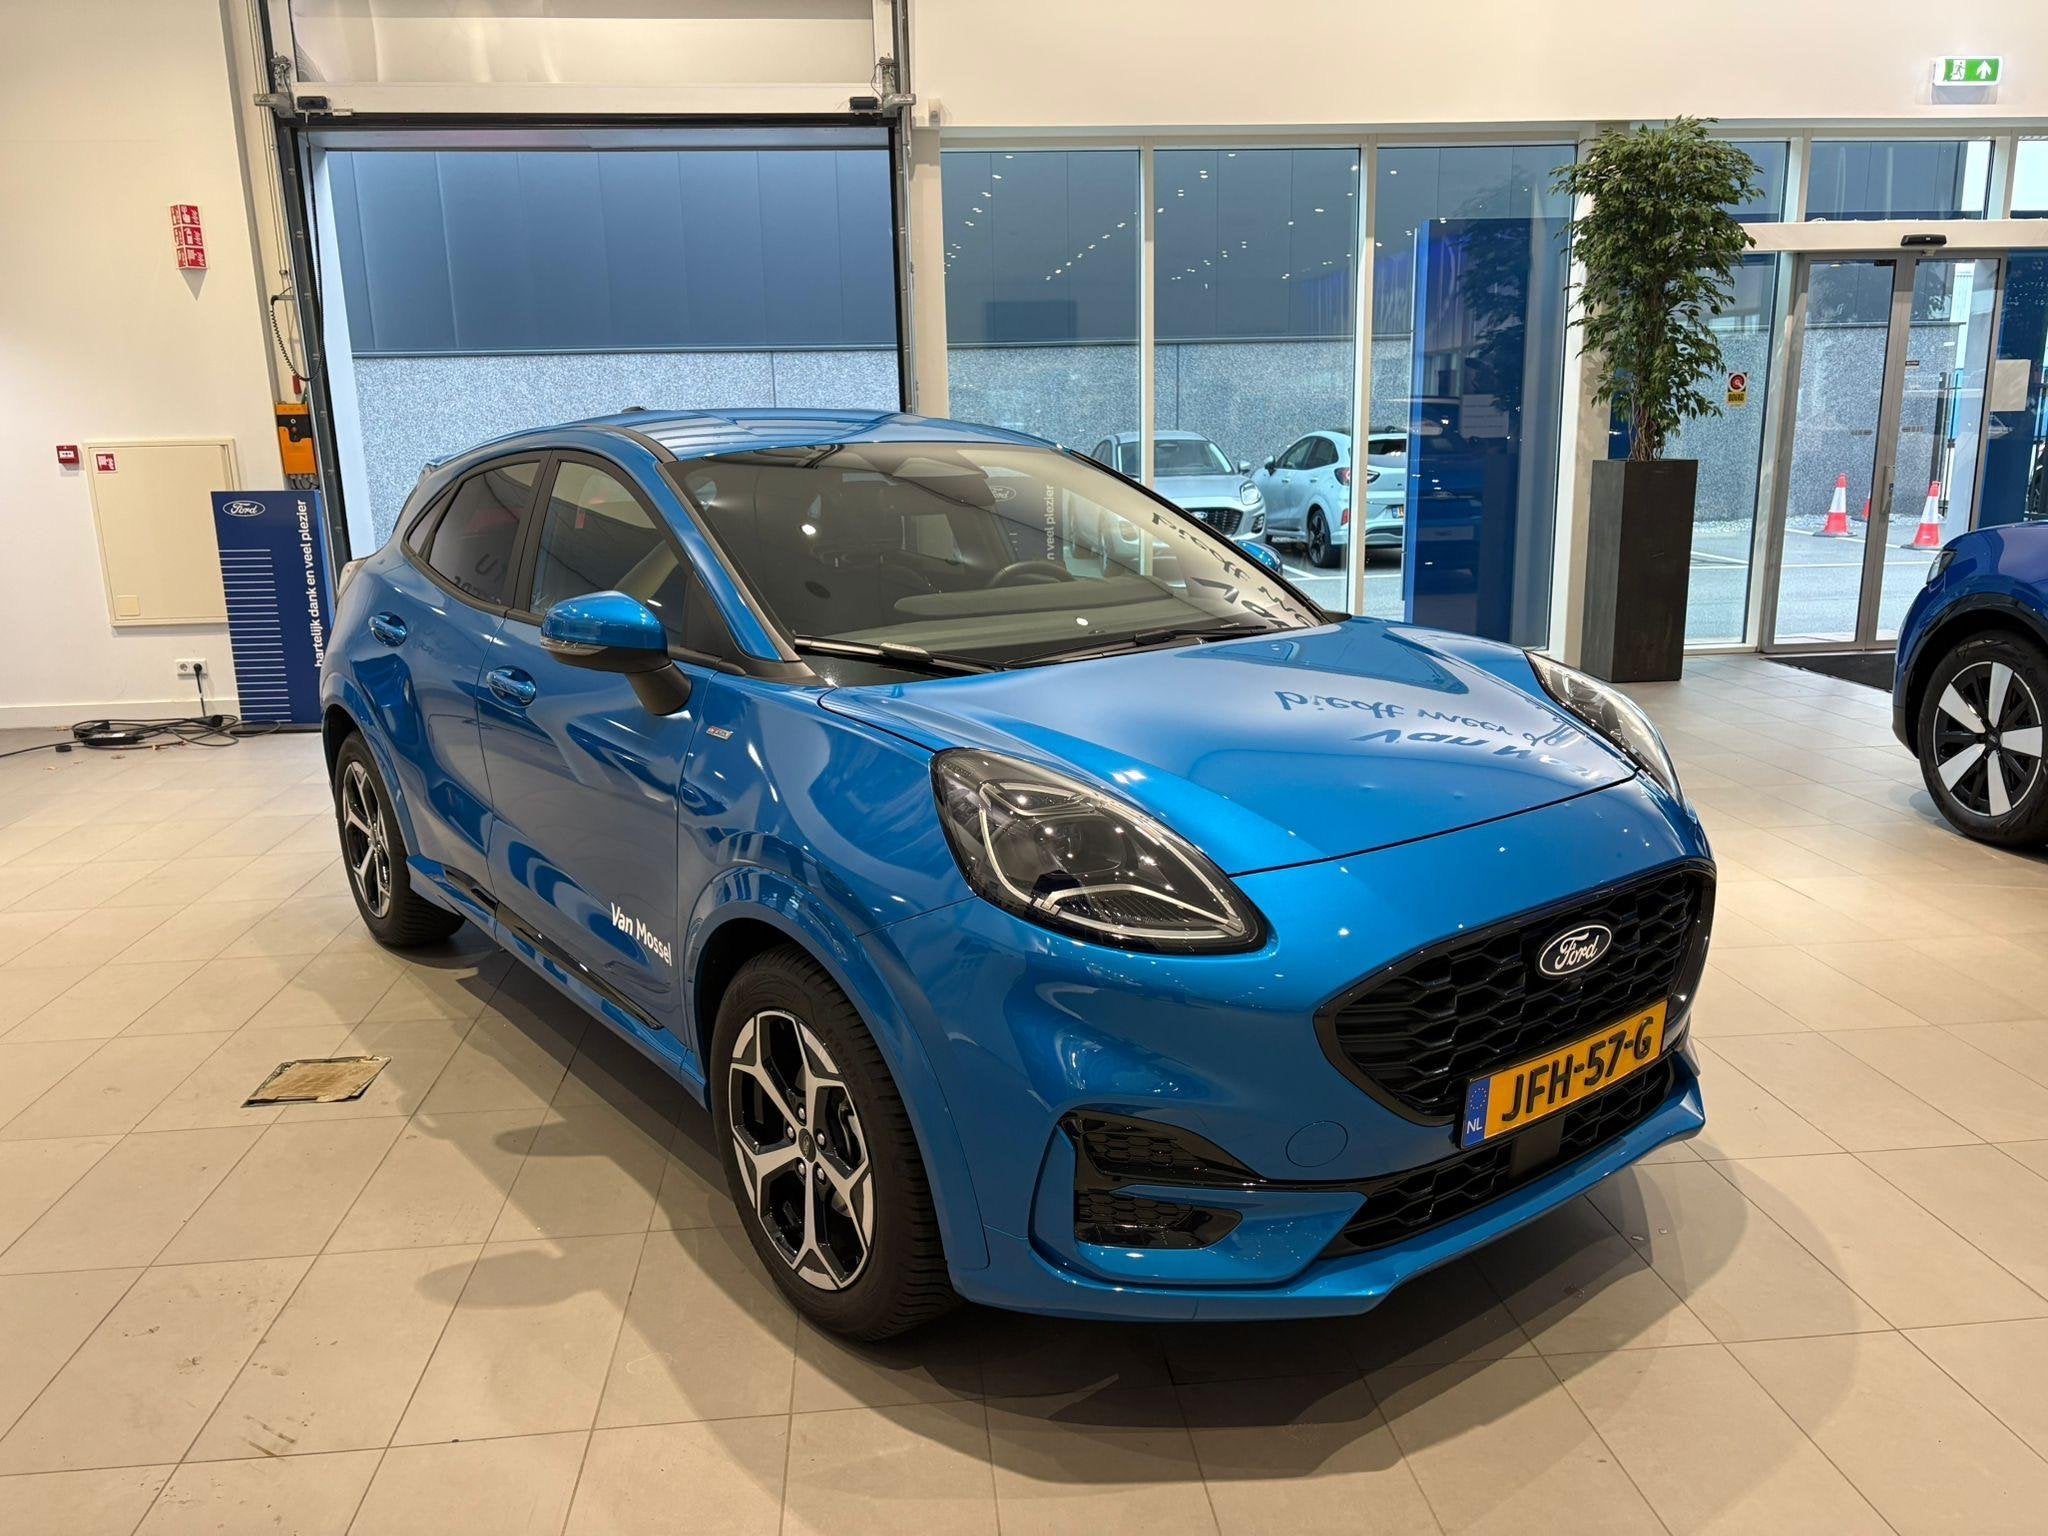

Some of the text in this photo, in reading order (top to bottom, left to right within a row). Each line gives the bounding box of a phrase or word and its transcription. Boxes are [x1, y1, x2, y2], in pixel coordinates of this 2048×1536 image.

[230, 503, 258, 514] Ford
[1043, 485, 1056, 524] plezier
[297, 500, 324, 668] hartelijk dank en veel plezier
[611, 902, 672, 967] Van Mossel
[1554, 931, 1600, 971] Ford
[1501, 1015, 1654, 1122] JFH-57-G
[1466, 1117, 1483, 1134] NL
